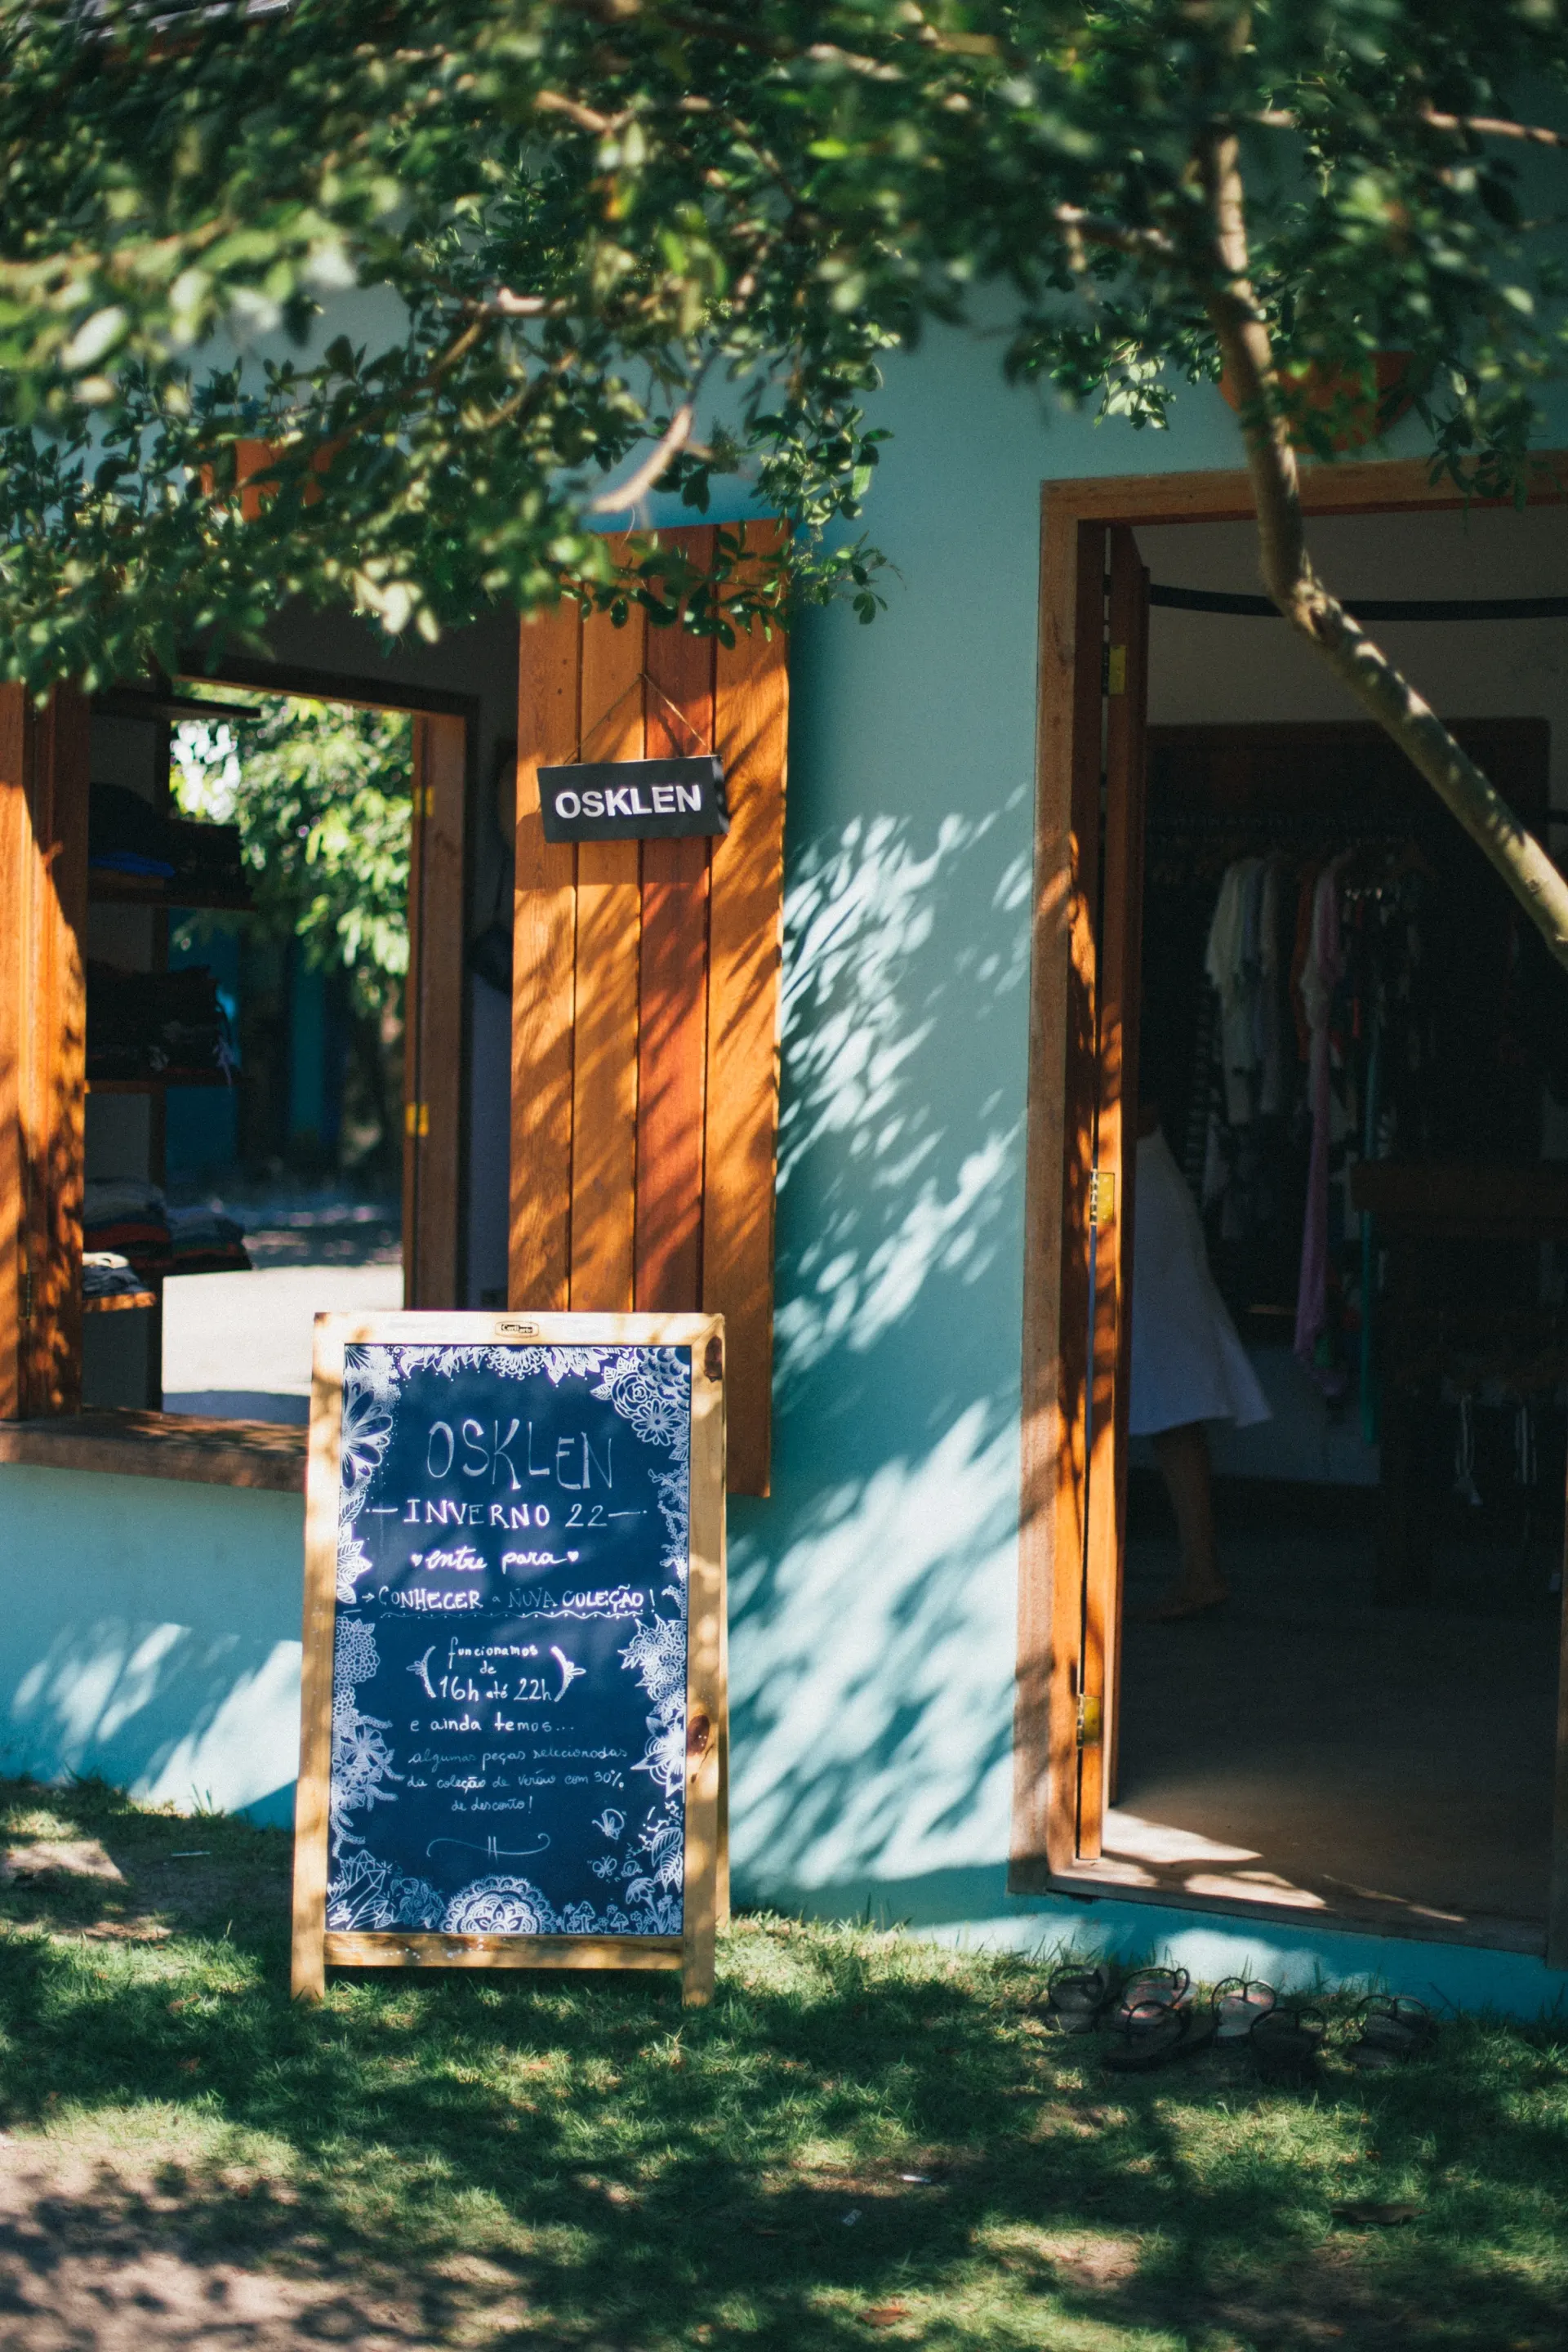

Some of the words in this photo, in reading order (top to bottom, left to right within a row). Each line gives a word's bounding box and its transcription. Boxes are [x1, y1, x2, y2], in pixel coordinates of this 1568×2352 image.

[555, 785, 702, 819] OSKLEN
[427, 1419, 612, 1490] OSKLEN
[403, 1499, 550, 1529] INVERNO
[564, 1503, 608, 1527] 22
[425, 1546, 488, 1570] entre
[501, 1552, 568, 1575] para
[378, 1585, 484, 1612] CONHECER
[448, 1637, 539, 1669] funcionamos
[479, 1660, 497, 1675] de
[439, 1676, 479, 1702] 16h
[485, 1681, 508, 1699] até
[514, 1677, 553, 1702] 22h
[410, 1719, 421, 1732] e
[430, 1713, 483, 1732] ainda
[408, 1748, 478, 1774] algumas
[482, 1750, 526, 1771] peças
[492, 1775, 510, 1788] de
[564, 1775, 589, 1785] com
[594, 1769, 625, 1789] 30%
[451, 1799, 467, 1811] de
